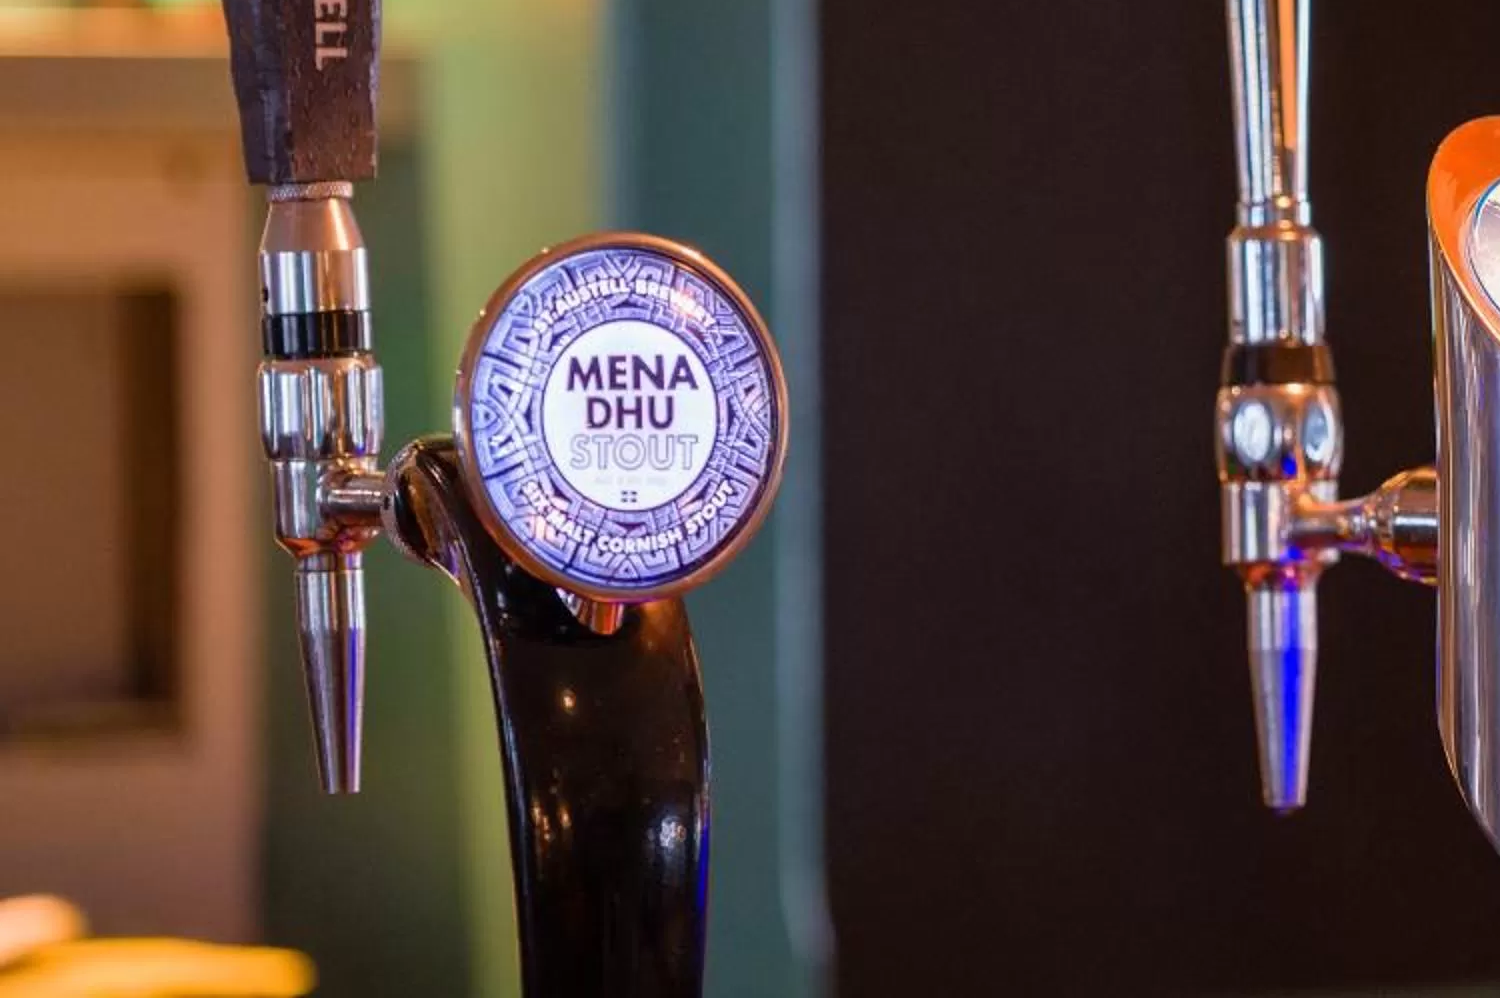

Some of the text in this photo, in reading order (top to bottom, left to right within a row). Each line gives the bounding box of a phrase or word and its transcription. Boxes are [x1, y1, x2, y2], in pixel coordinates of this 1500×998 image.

[555, 277, 631, 317] AUSTELL
[635, 278, 717, 328] BREWERY
[566, 355, 699, 392] MENA
[586, 396, 675, 430] DHU
[570, 434, 699, 471] STOUT
[597, 526, 683, 553] CORNISH
[686, 478, 735, 535] STOUT
